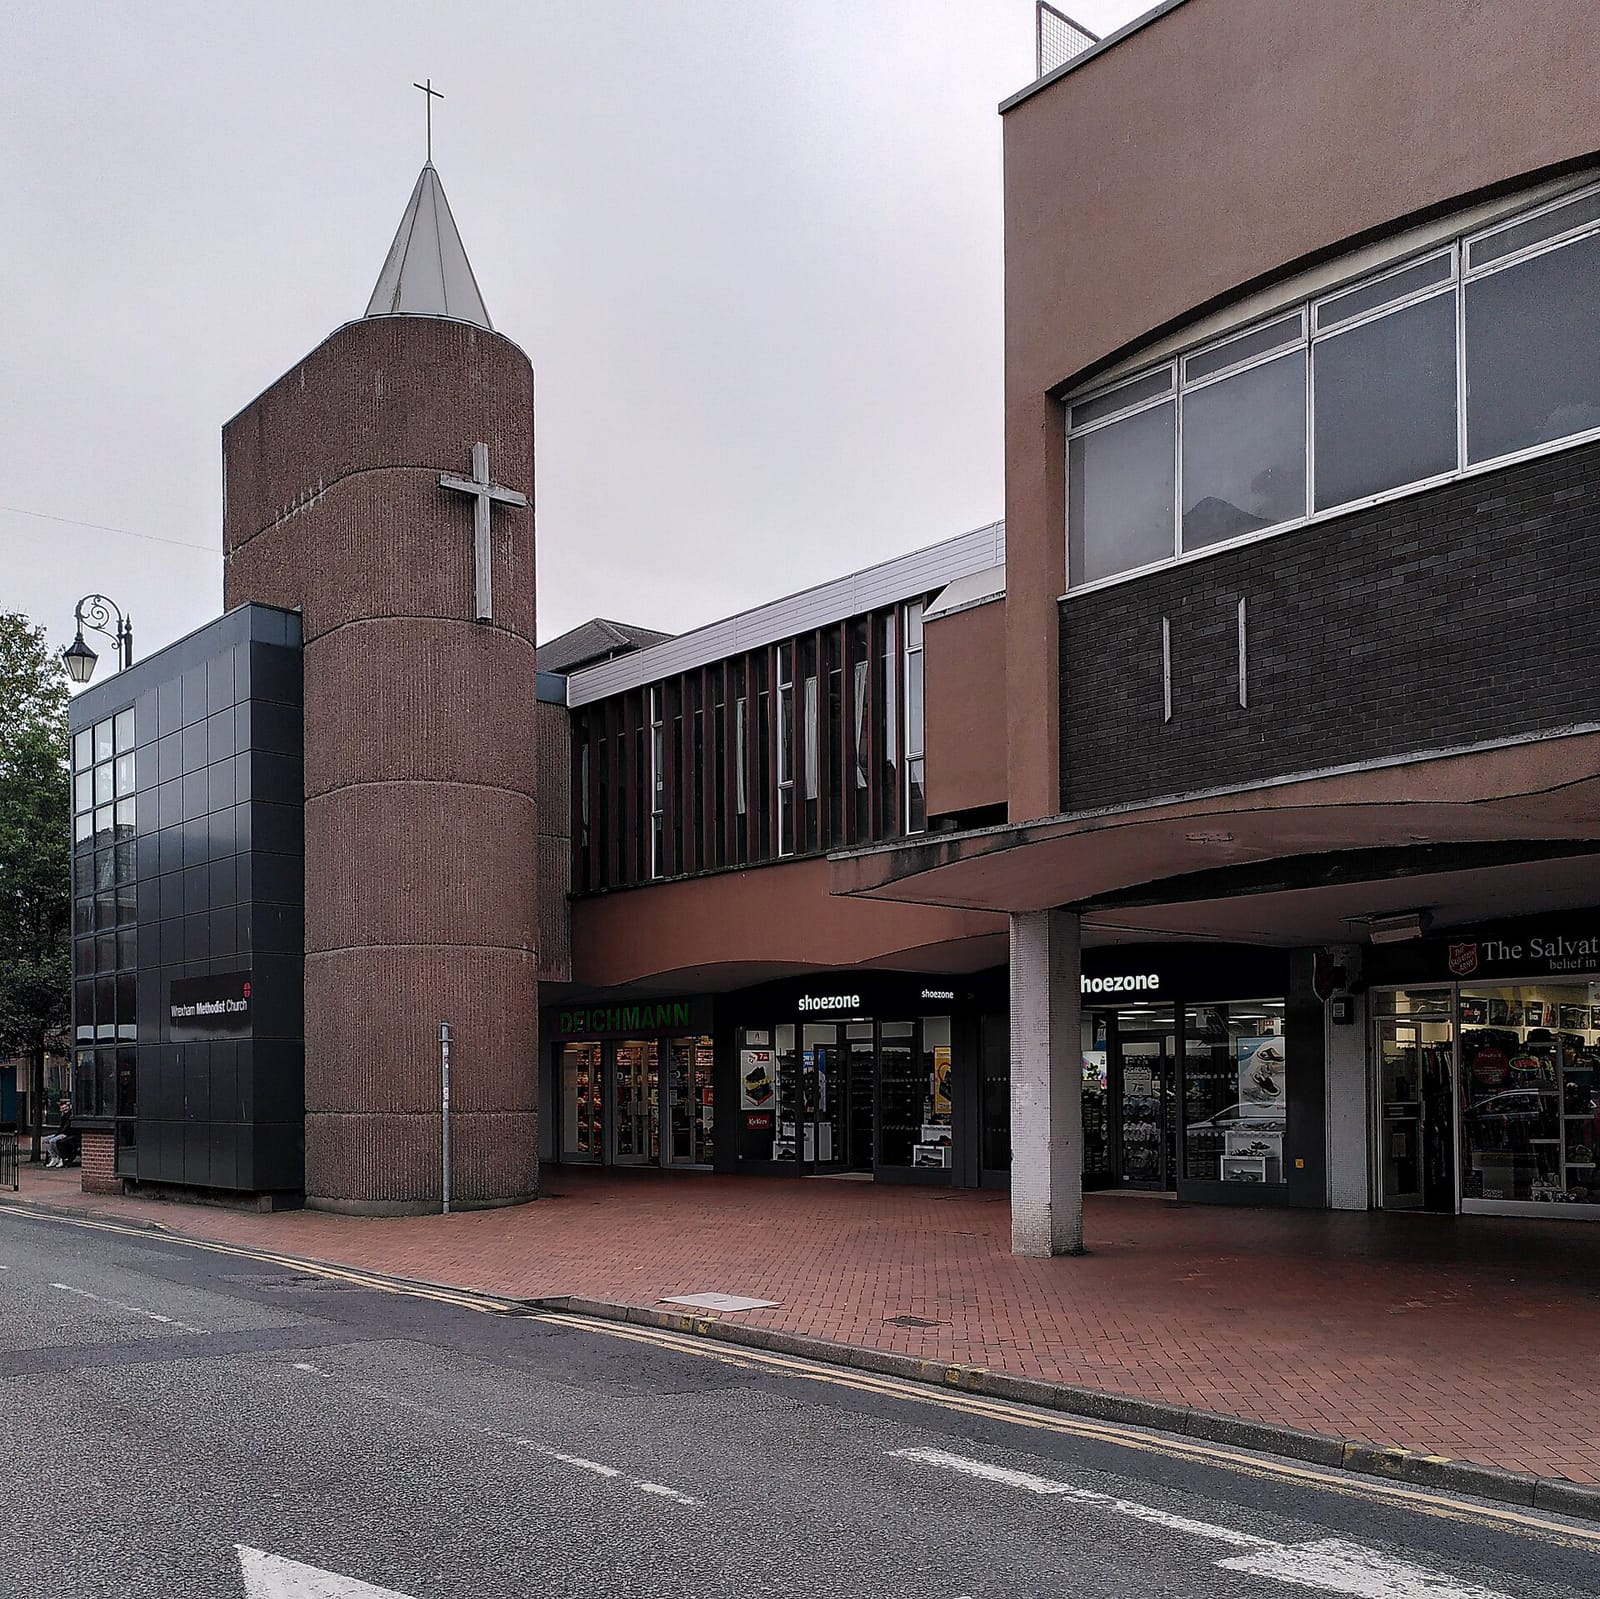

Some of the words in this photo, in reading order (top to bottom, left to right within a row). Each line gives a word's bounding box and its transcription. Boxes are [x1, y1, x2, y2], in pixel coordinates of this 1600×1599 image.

[1481, 940, 1523, 961] The
[1530, 935, 1600, 959] Salvat
[1549, 957, 1584, 970] belief
[1586, 957, 1597, 968] in
[1080, 973, 1160, 993] hoezone
[798, 994, 860, 1011] shoezone
[921, 988, 954, 1000] shoezone
[170, 1004, 196, 1018] Wrexham
[196, 1000, 226, 1016] Methodist
[226, 997, 248, 1013] Church
[559, 1003, 689, 1033] DEICHMANN
